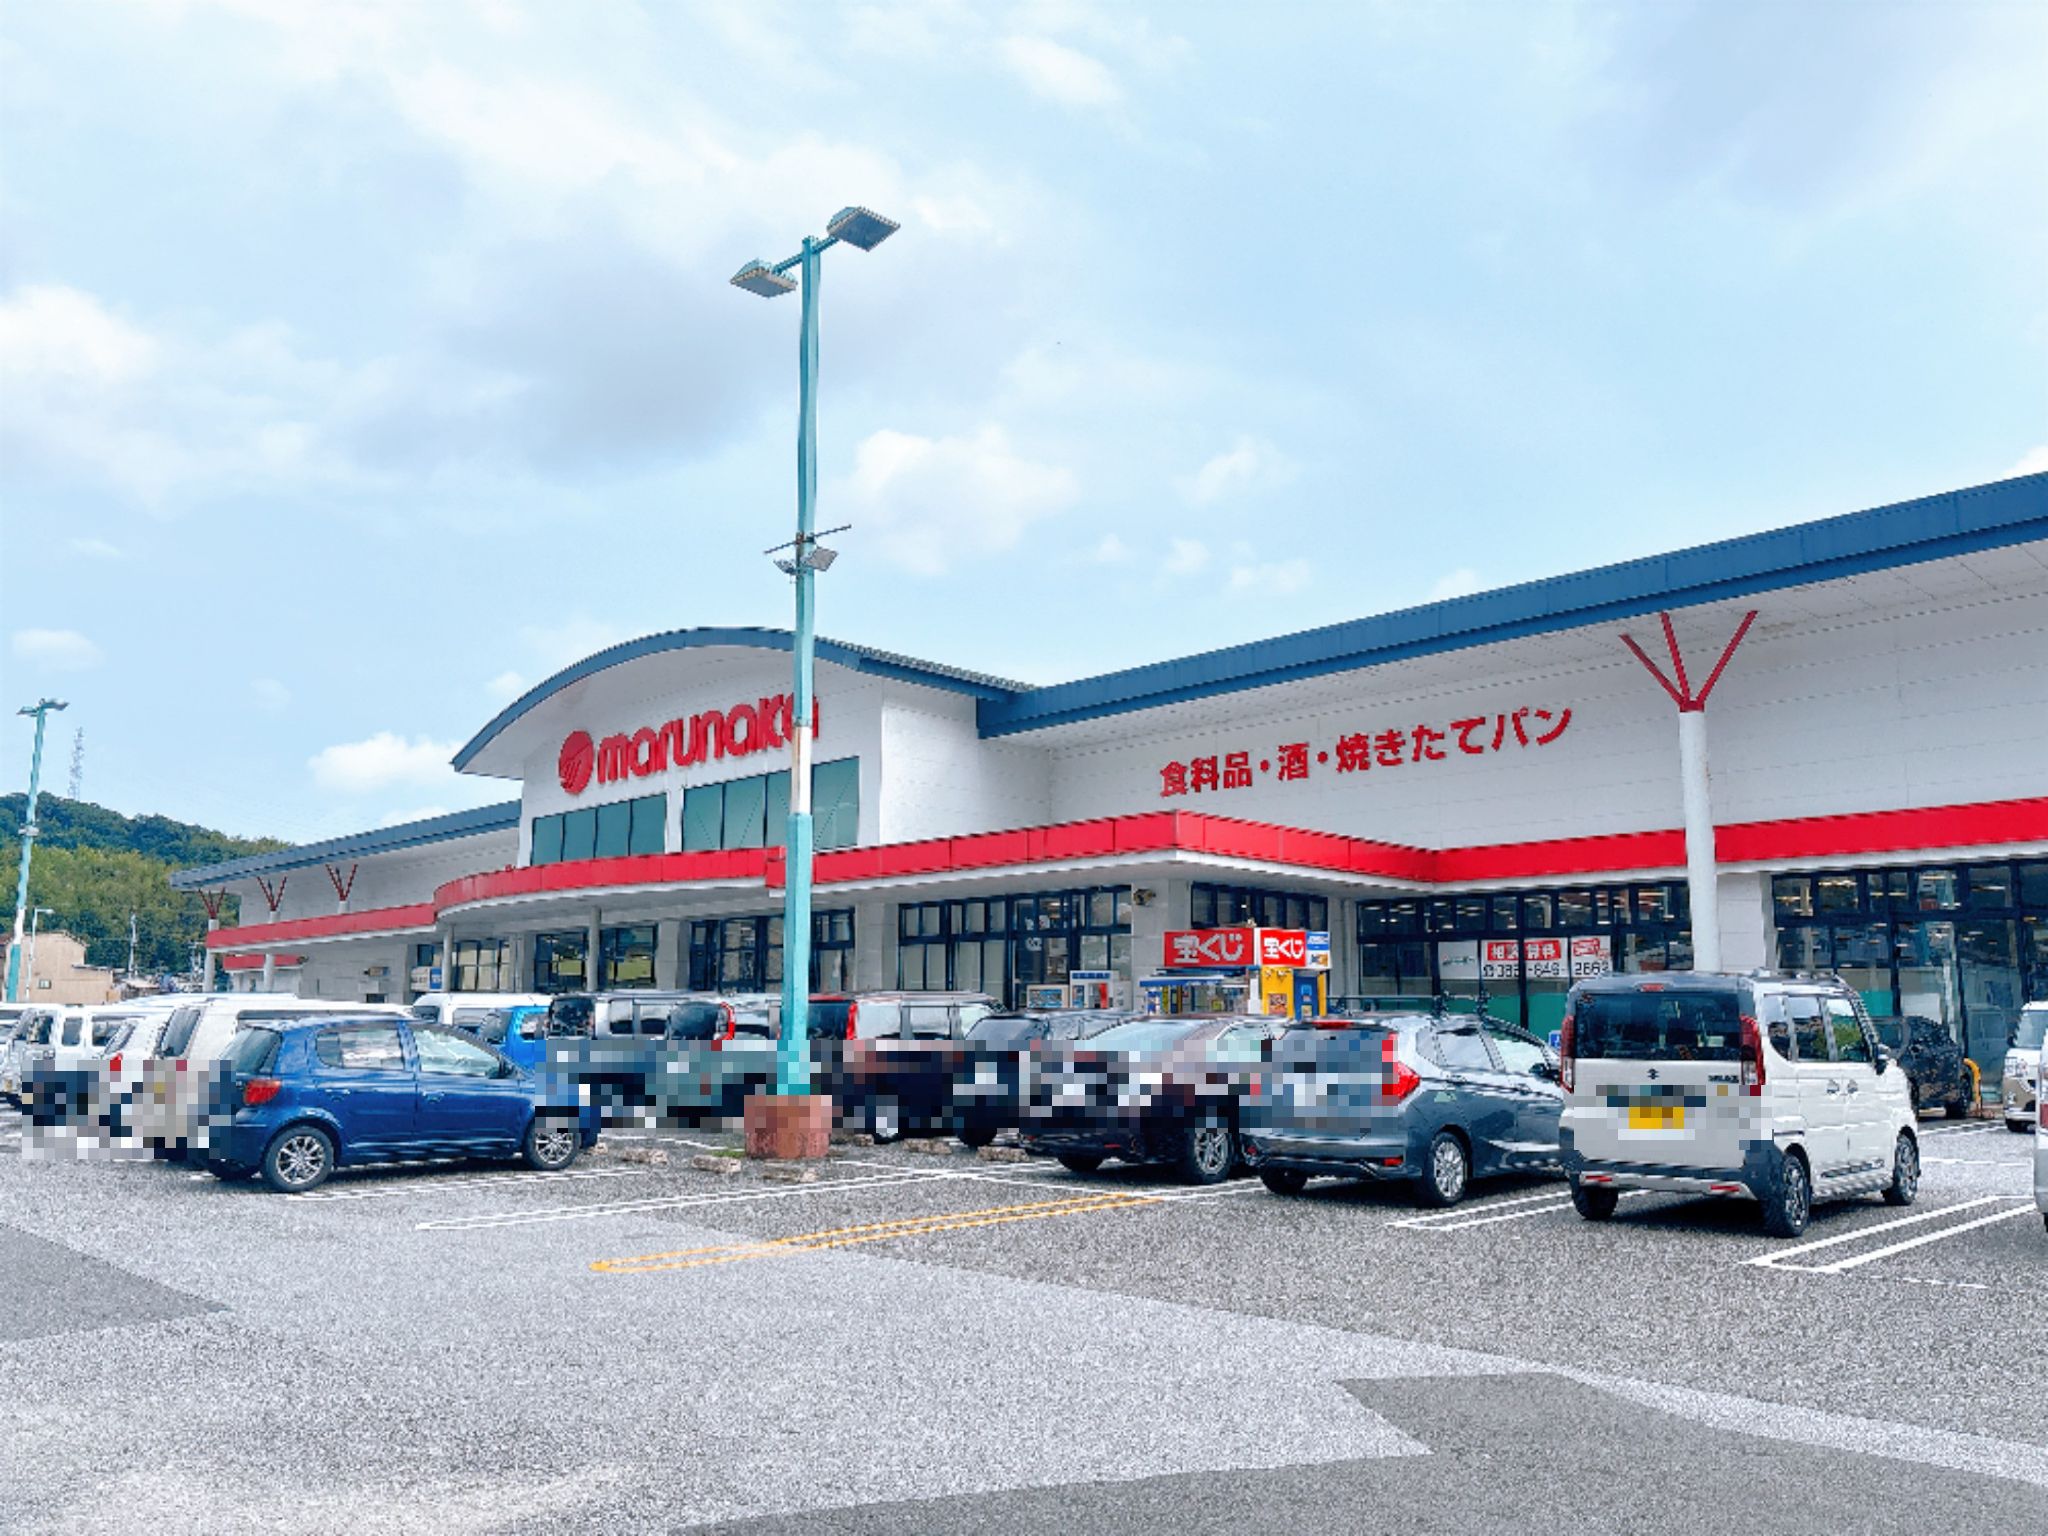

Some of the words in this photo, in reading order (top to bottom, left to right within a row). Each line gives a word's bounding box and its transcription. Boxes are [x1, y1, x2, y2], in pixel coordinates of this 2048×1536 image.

[1159, 705, 1571, 798] 食料品・酒・焼きたてパン
[1173, 932, 1244, 963] 宝くじ
[1264, 937, 1304, 959] 宝くじ
